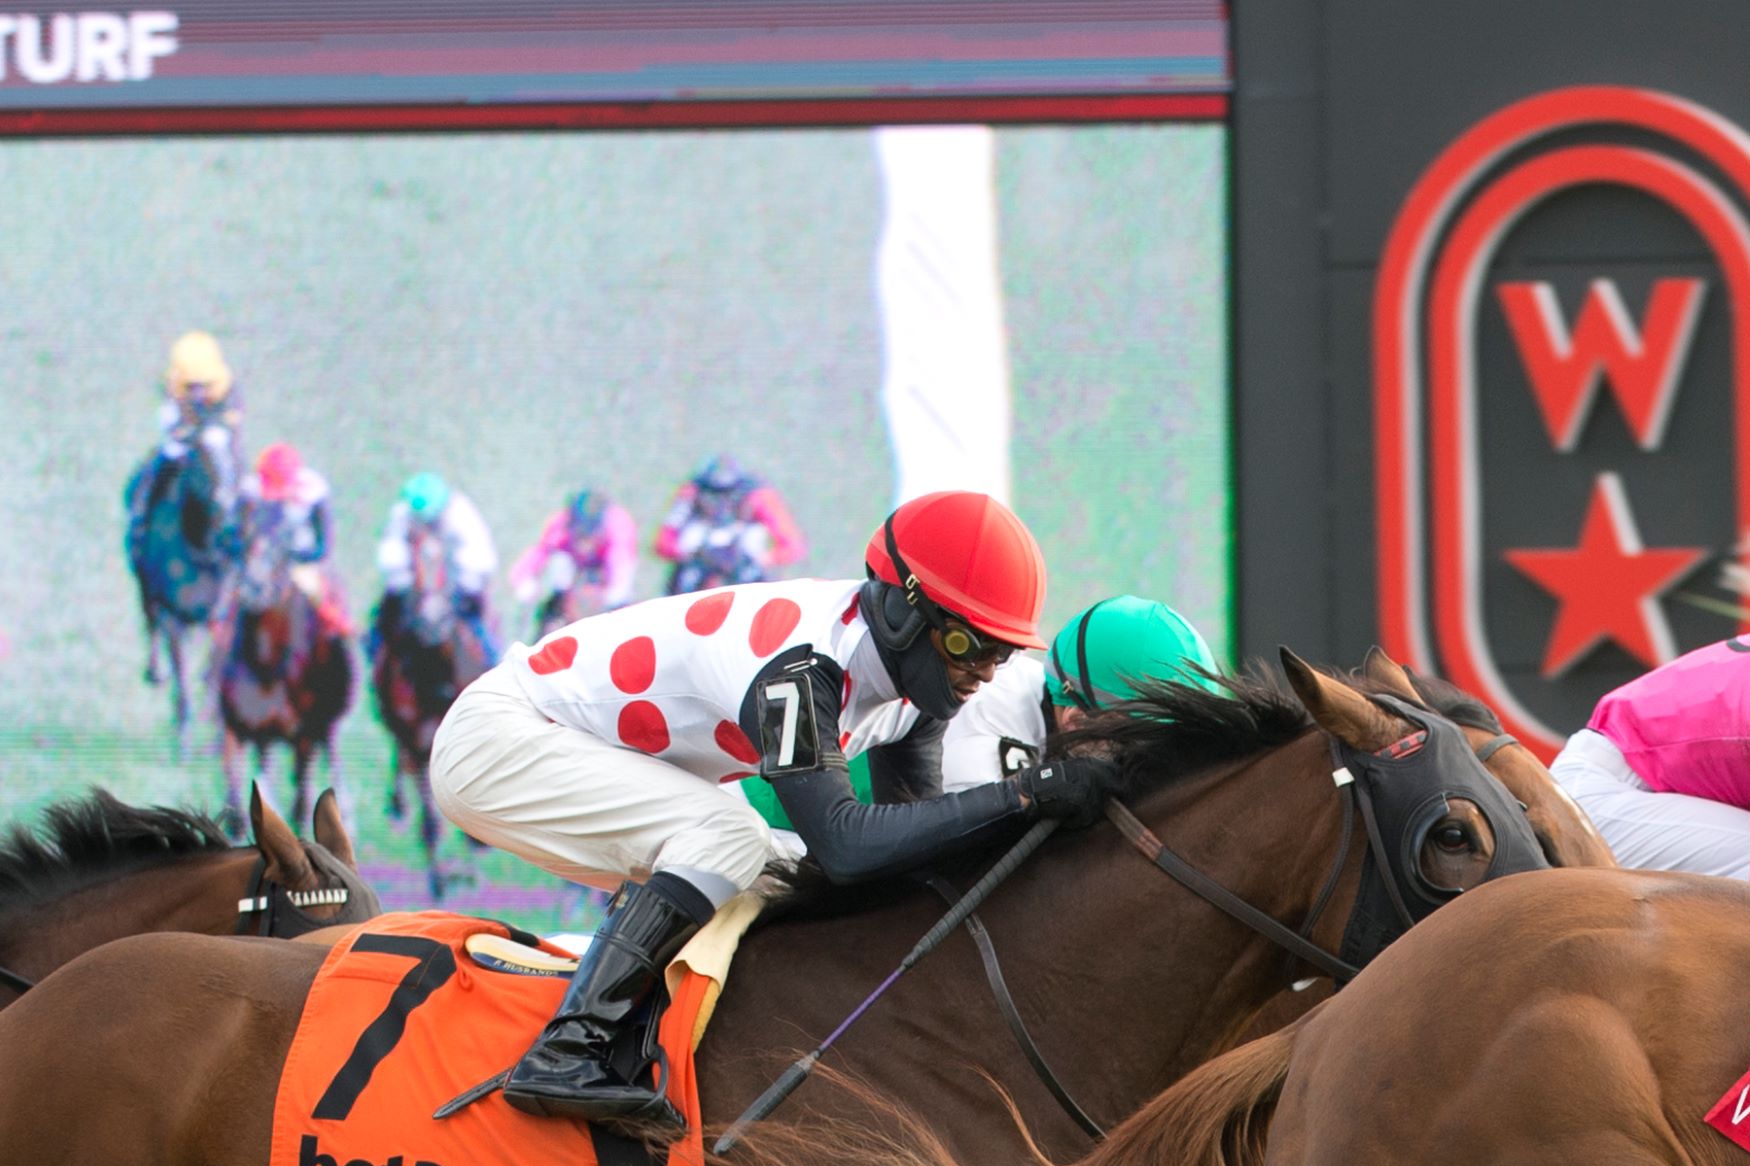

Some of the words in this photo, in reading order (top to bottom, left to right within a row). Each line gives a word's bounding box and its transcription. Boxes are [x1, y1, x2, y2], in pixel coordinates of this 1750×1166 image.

[1495, 276, 1706, 453] W
[764, 681, 800, 767] 7
[311, 932, 458, 1121] 7
